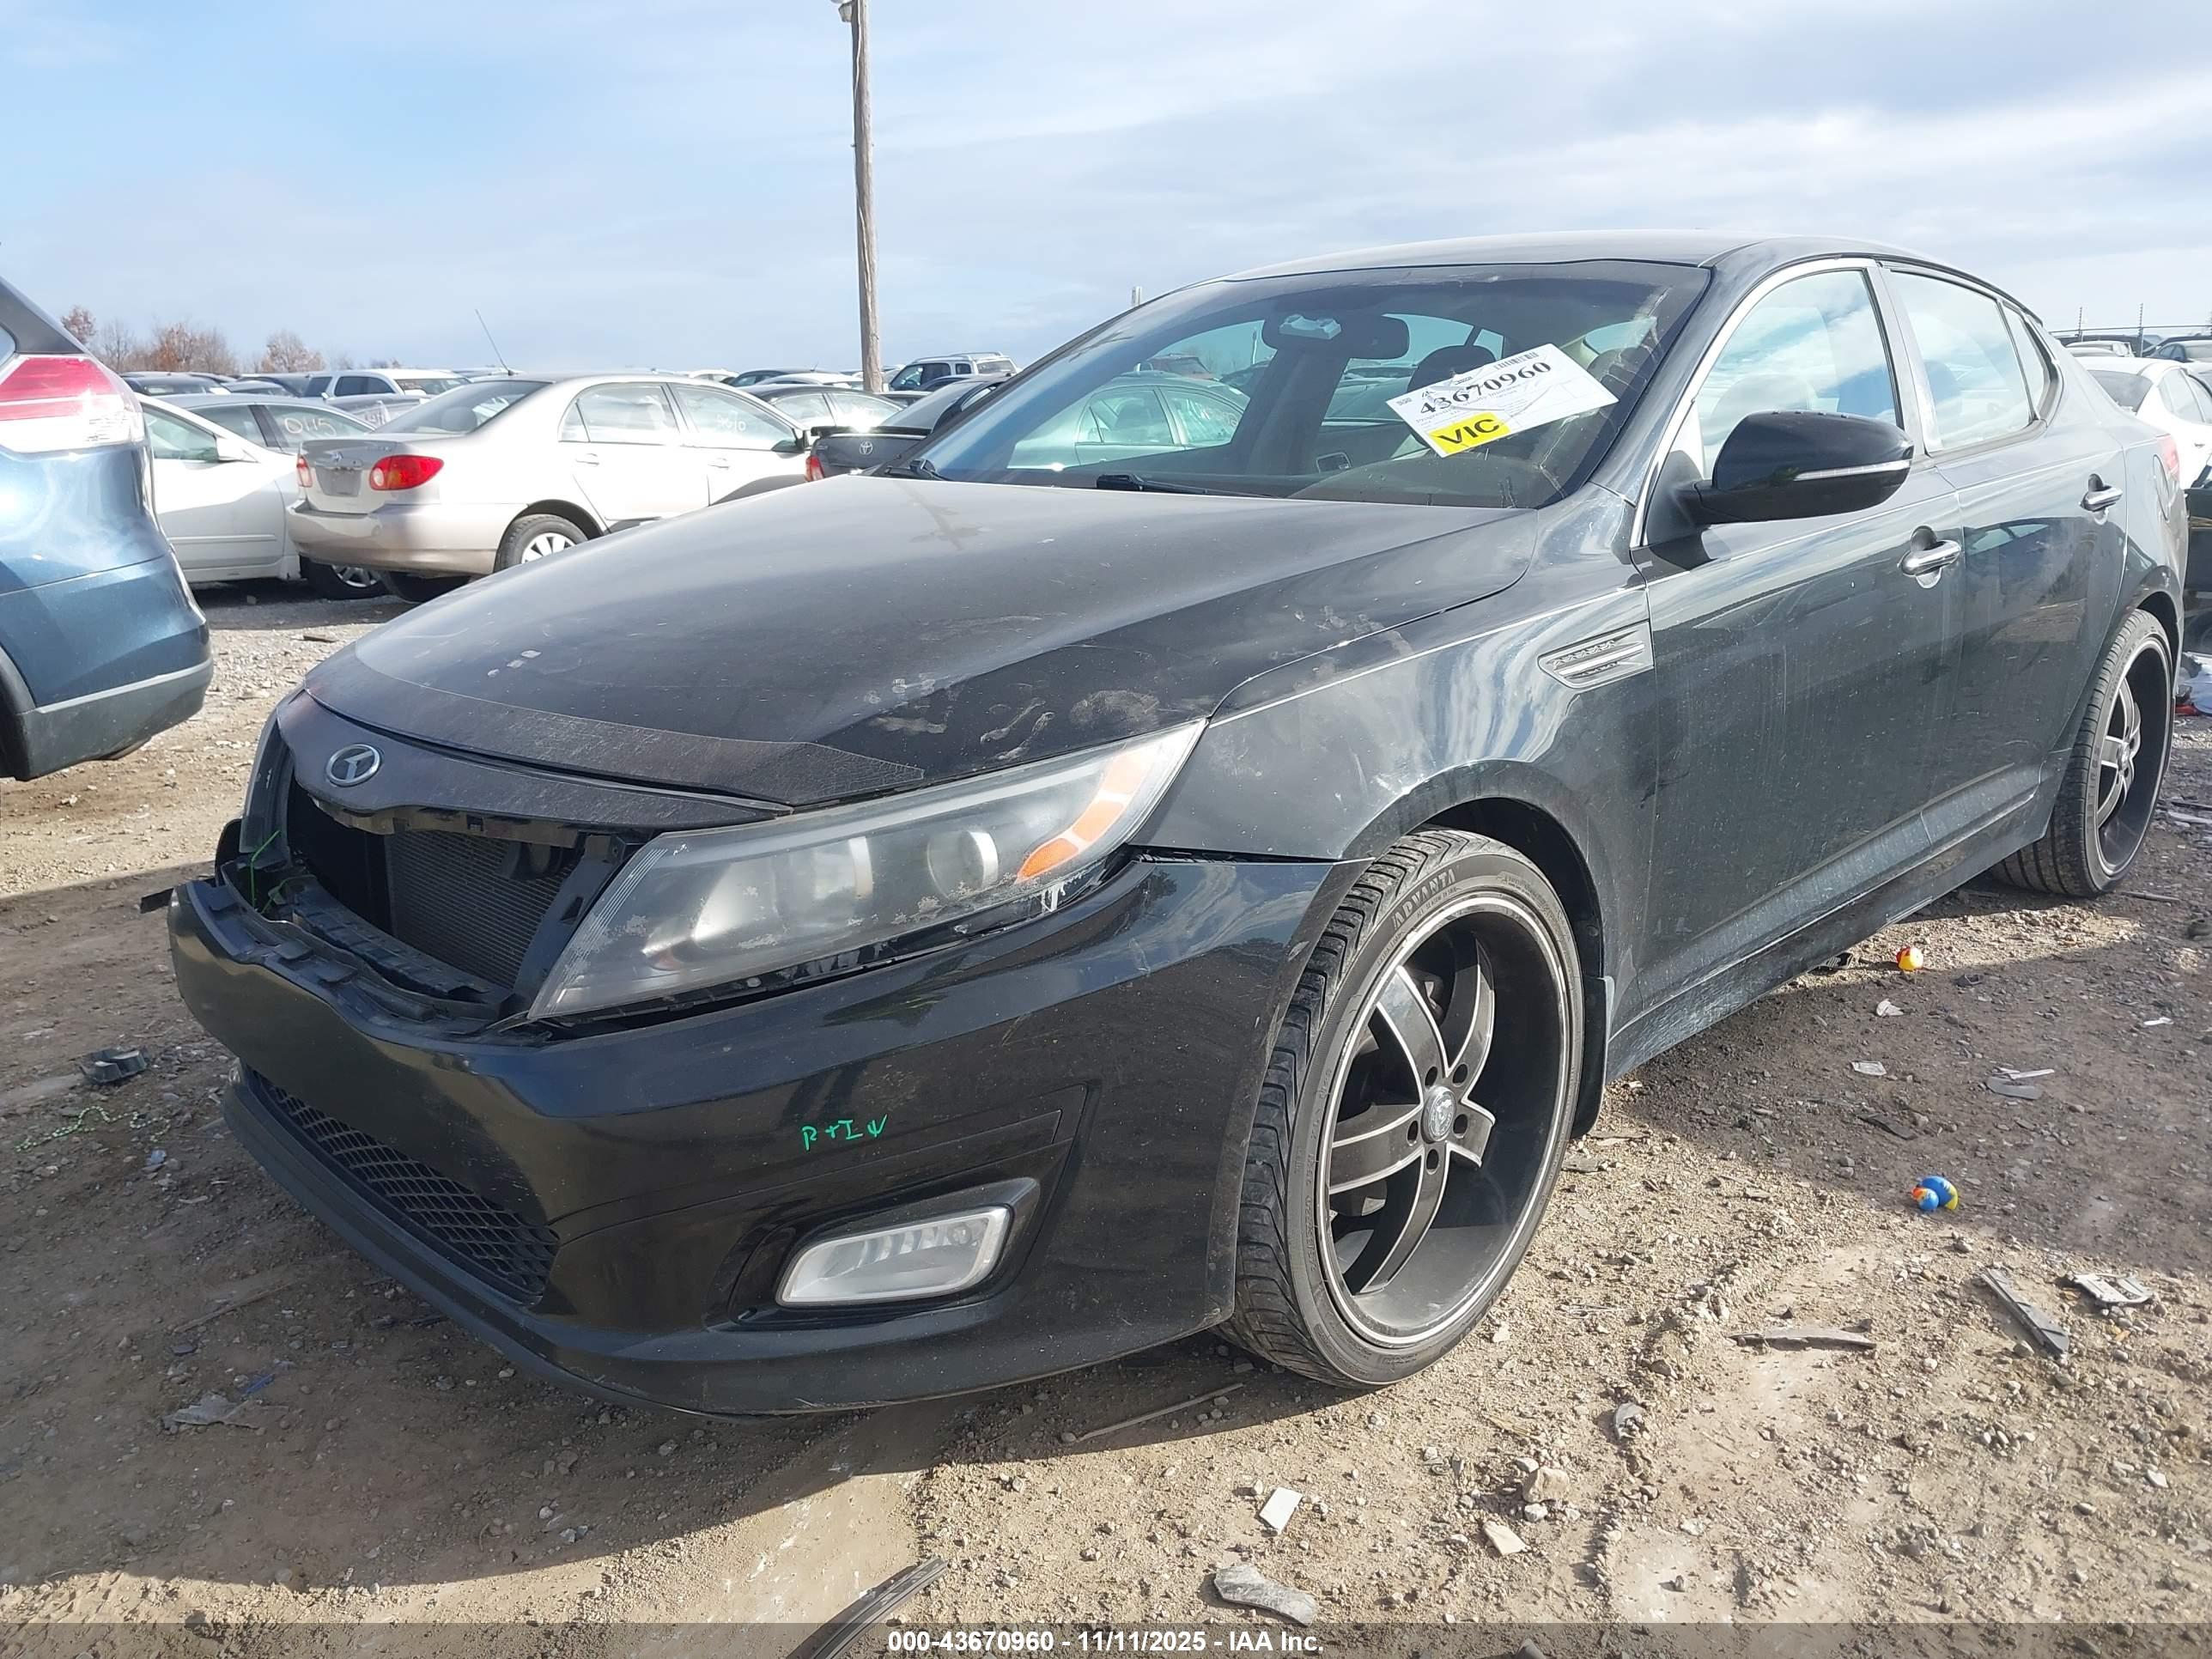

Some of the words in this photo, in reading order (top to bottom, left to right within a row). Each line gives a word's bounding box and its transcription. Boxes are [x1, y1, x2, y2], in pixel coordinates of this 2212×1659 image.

[1420, 361, 1552, 415] 43670960
[1437, 418, 1500, 445] VIC
[1392, 868, 1455, 931] ADVANTA
